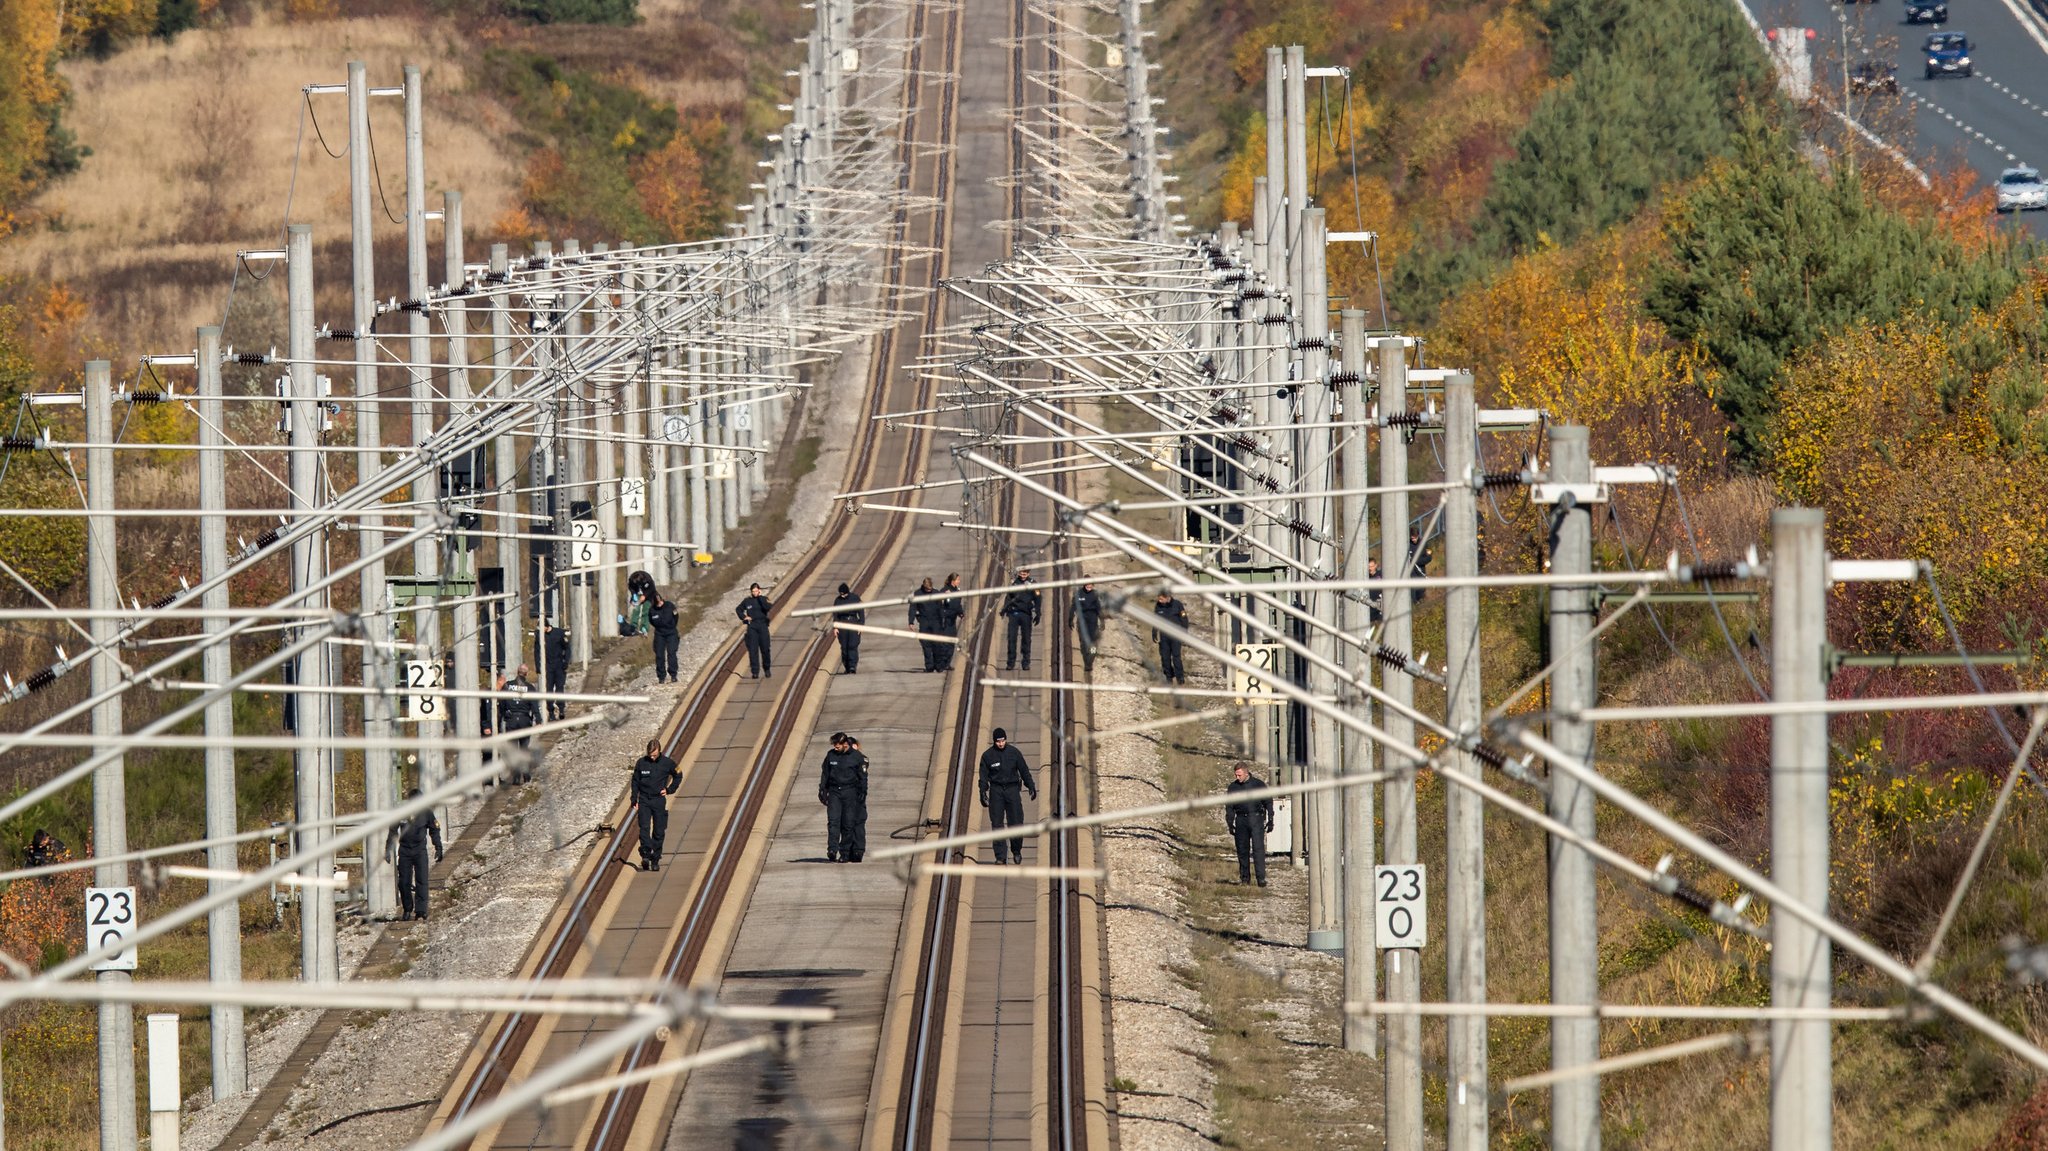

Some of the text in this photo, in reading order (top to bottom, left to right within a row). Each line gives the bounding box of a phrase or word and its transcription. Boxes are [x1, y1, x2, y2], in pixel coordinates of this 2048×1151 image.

[630, 497, 638, 510] 4
[574, 524, 598, 538] 22
[581, 543, 591, 561] 6
[1238, 648, 1271, 672] 22
[410, 664, 443, 688] 22
[1246, 675, 1261, 693] 8
[420, 695, 435, 714] 8
[1378, 869, 1421, 902] 23
[89, 891, 132, 925] 23
[1388, 906, 1413, 939] 0
[100, 929, 124, 961] 0
